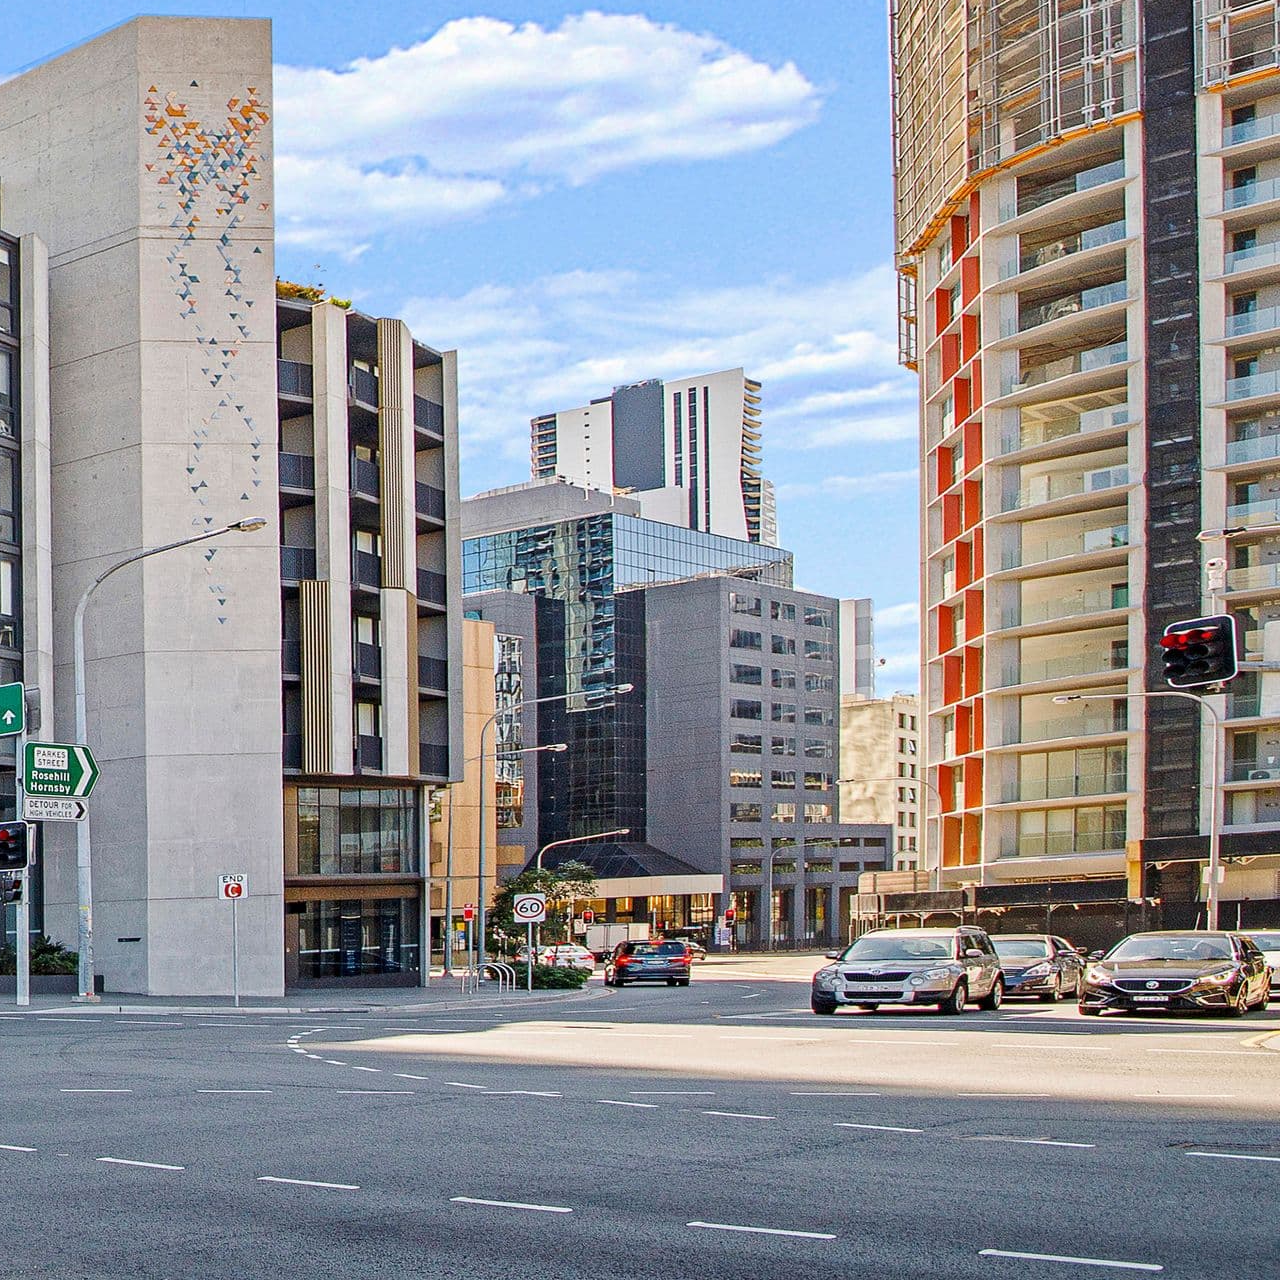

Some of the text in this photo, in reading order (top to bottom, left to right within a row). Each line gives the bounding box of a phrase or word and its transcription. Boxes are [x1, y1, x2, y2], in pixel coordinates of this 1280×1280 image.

[36, 749, 66, 759] PARKES
[38, 758, 65, 767] STREET
[31, 770, 70, 782] Rosehill
[30, 781, 71, 795] Hornsby
[29, 800, 59, 809] DETOUR
[222, 874, 244, 883] END
[228, 883, 239, 897] C
[519, 902, 540, 913] 60
